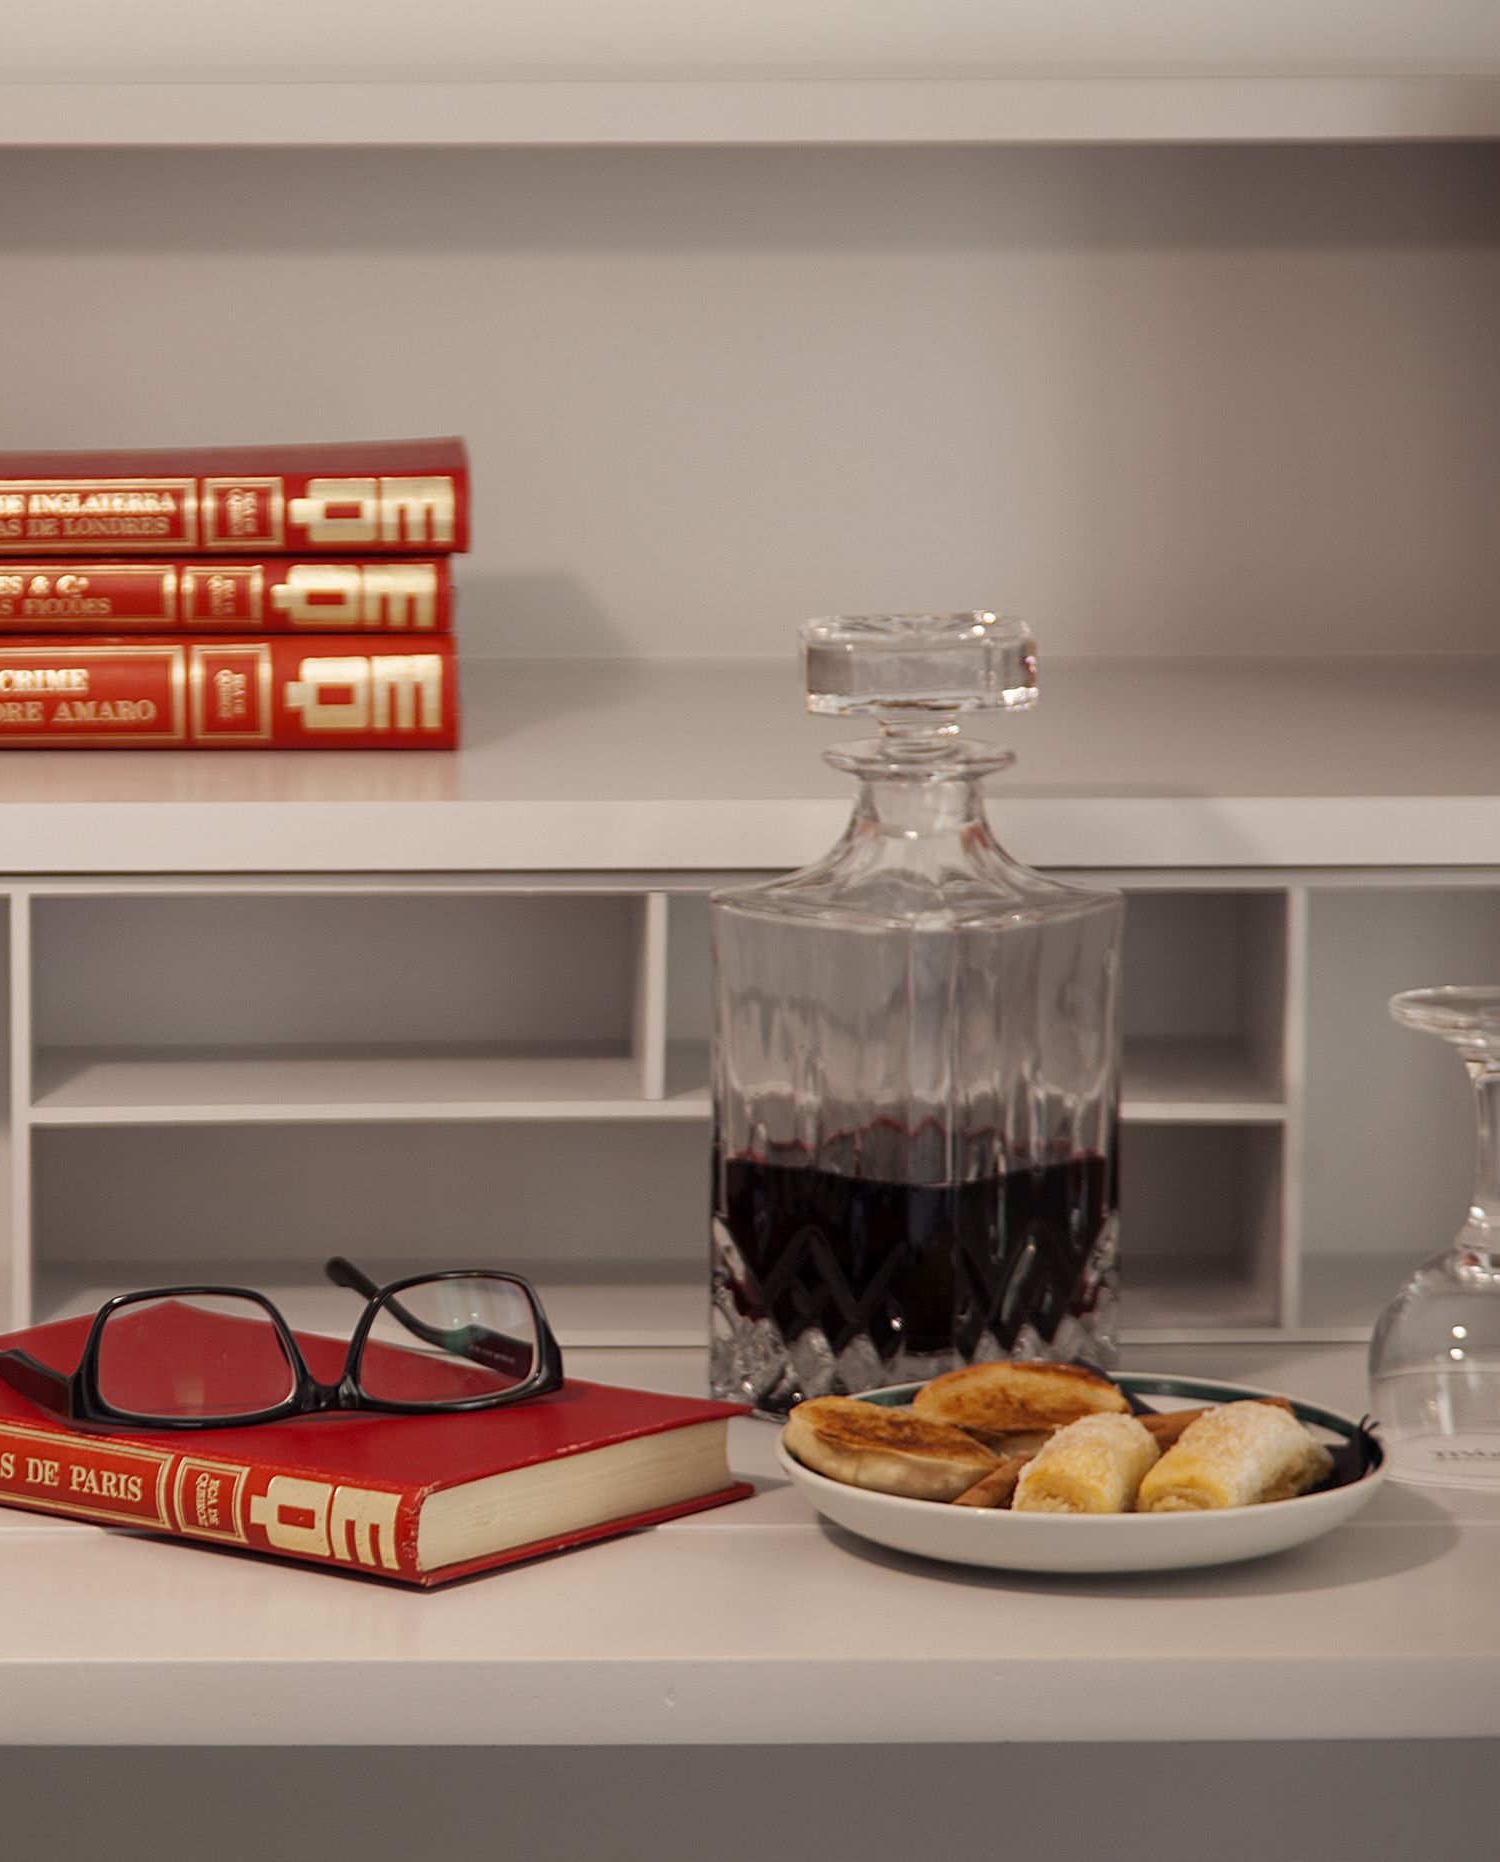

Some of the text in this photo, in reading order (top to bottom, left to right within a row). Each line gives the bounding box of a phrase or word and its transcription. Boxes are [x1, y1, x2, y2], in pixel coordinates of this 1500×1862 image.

[28, 492, 178, 517] INGLATERRA
[25, 518, 60, 537] DE
[61, 515, 172, 537] LONDRES
[28, 575, 51, 597] &
[50, 699, 158, 722] AMARO
[25, 1457, 60, 1487] DE
[69, 1464, 143, 1503] PARIS
[195, 1472, 209, 1527] QUEIROZ
[207, 1508, 219, 1526] DE
